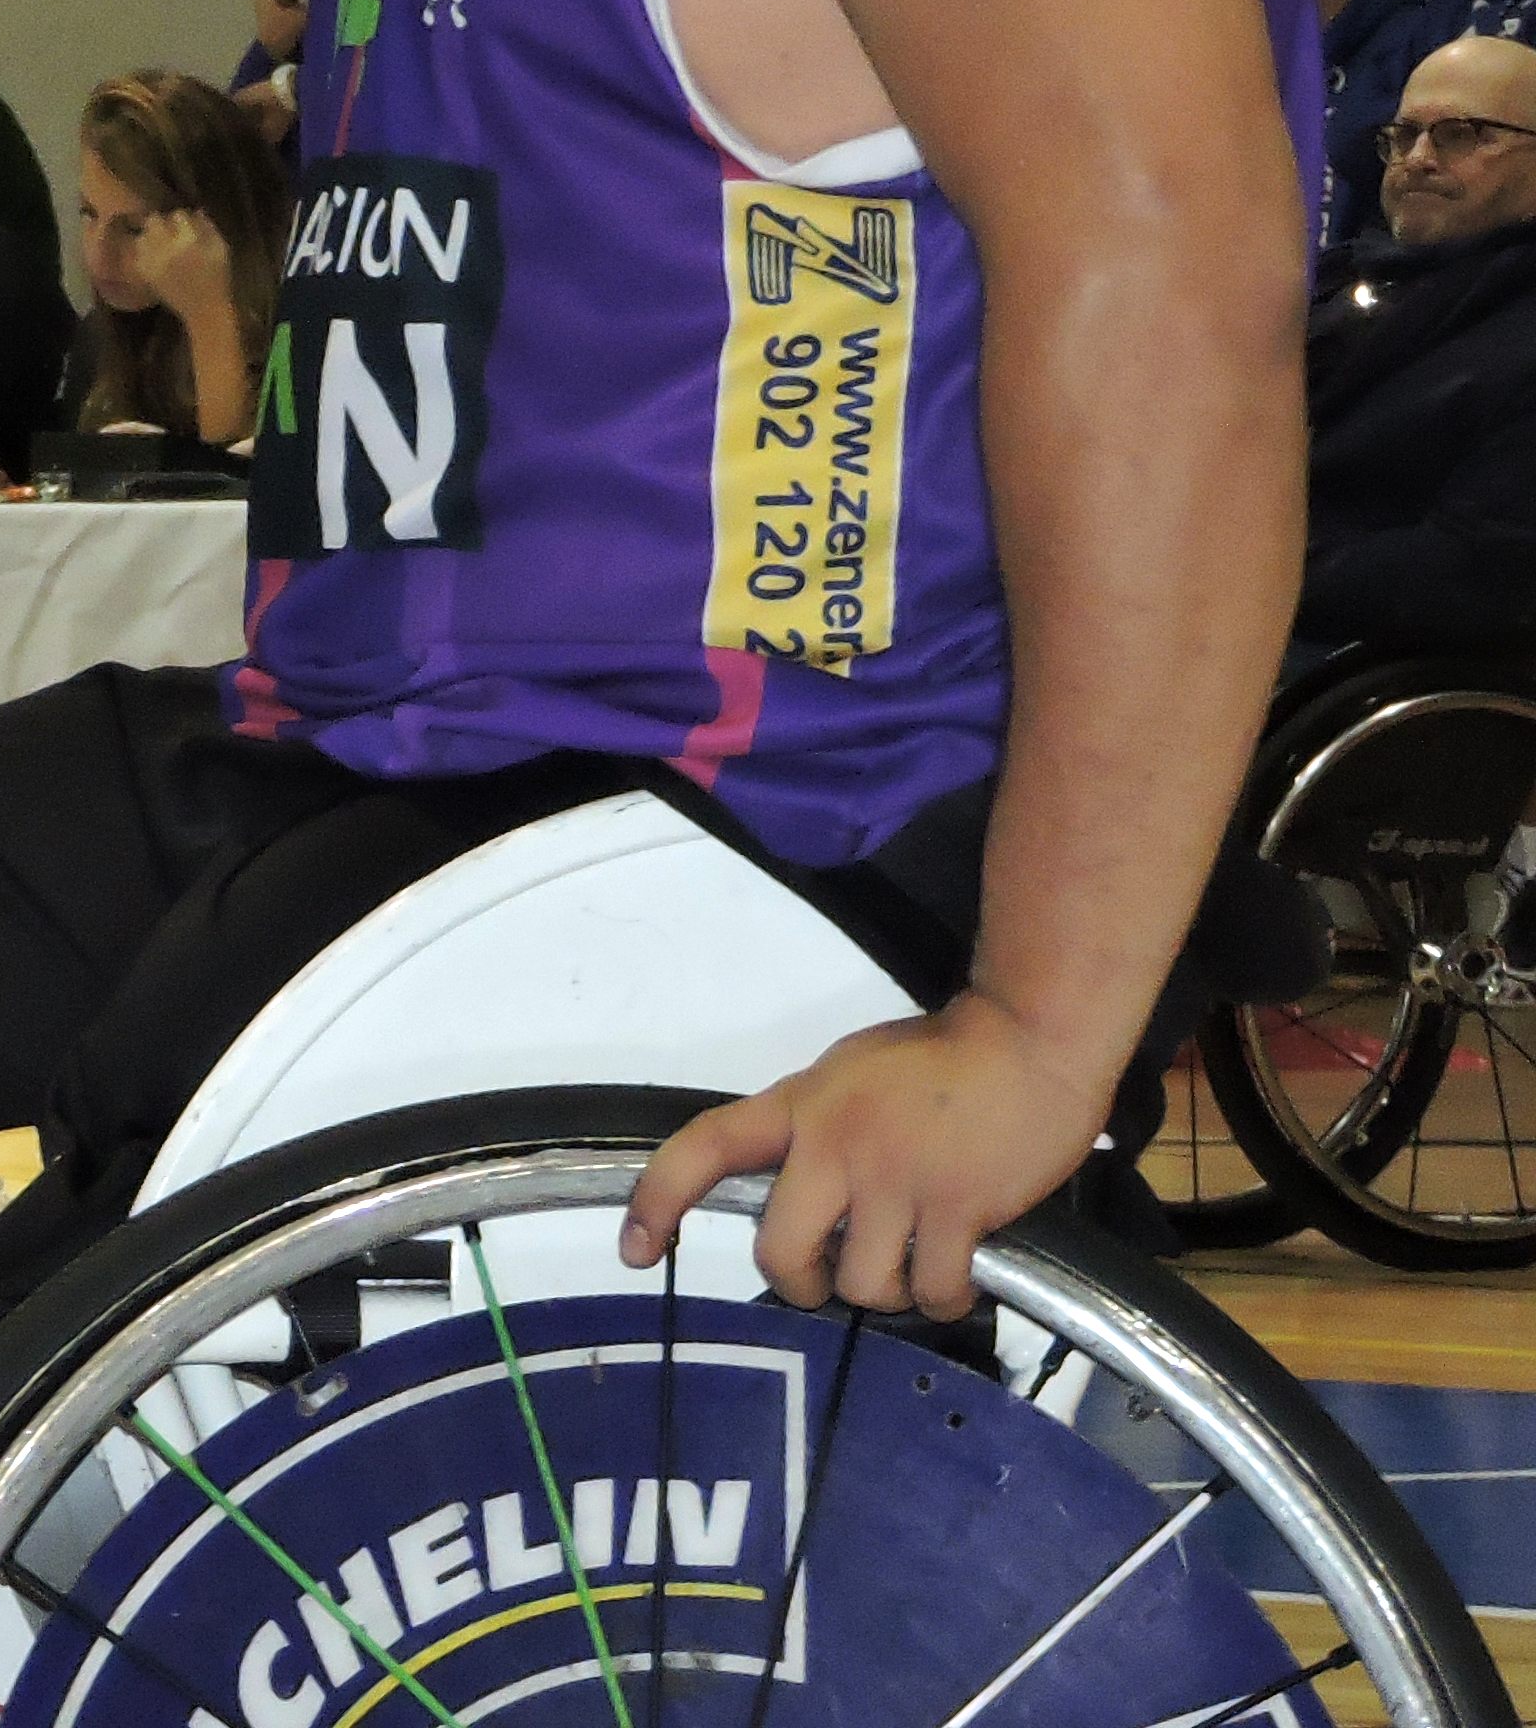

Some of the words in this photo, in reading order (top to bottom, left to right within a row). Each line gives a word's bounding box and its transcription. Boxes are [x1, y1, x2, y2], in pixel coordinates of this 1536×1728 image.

[755, 333, 822, 450] 902
[746, 480, 814, 601] 120
[190, 1478, 752, 1728] CHELIN
